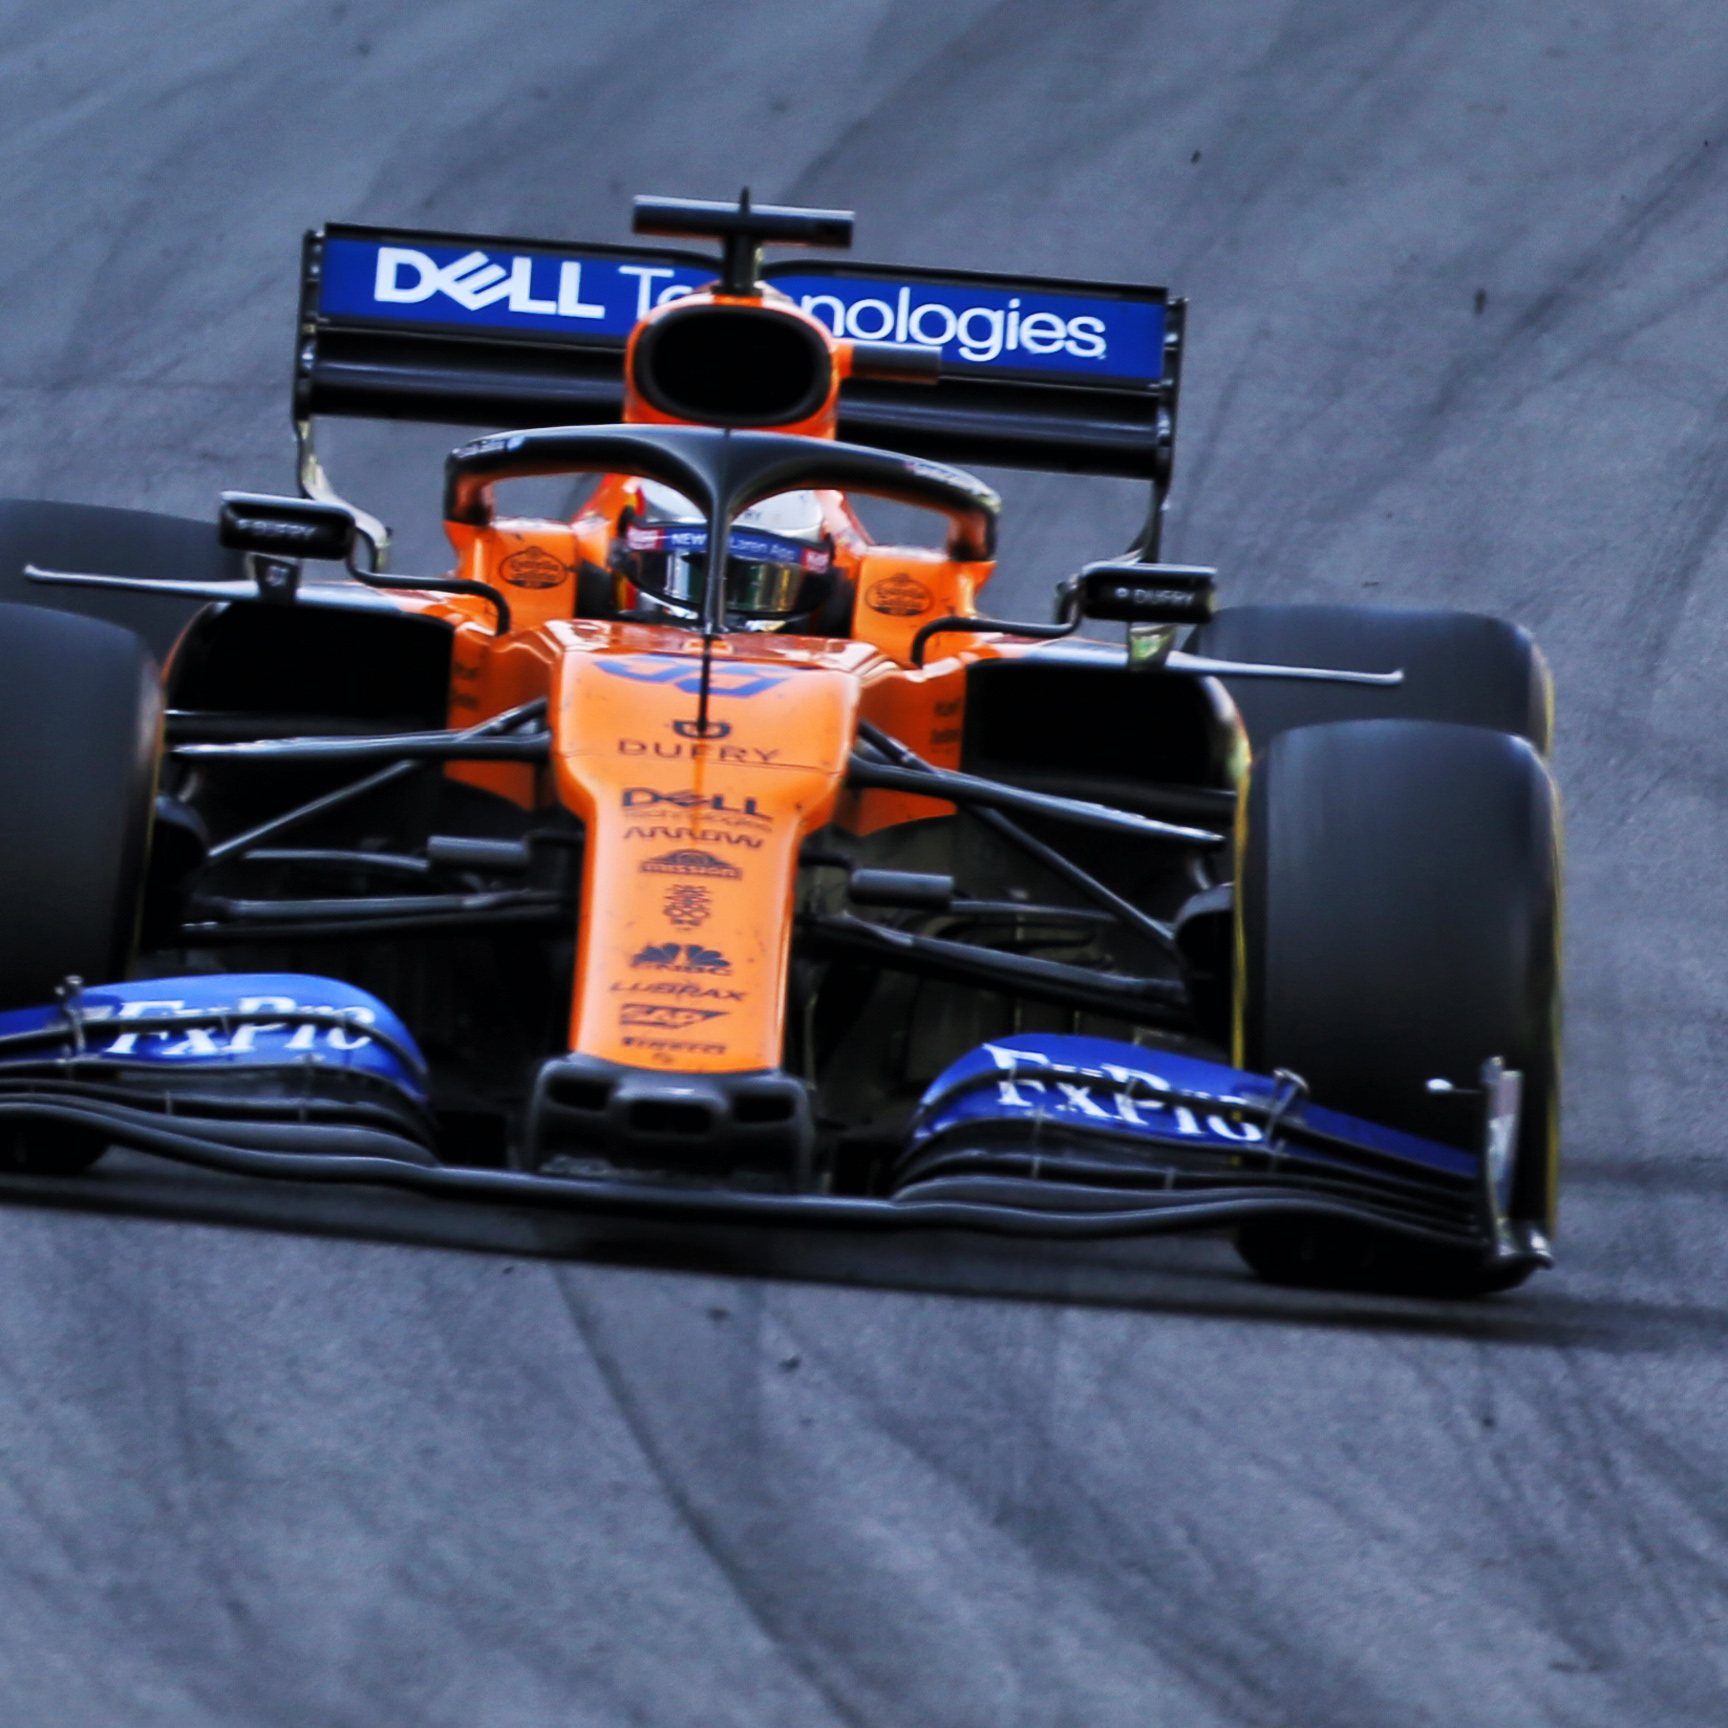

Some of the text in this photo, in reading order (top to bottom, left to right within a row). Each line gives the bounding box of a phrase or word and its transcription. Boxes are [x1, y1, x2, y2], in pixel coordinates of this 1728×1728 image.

[373, 246, 1107, 363] DELL Tnologies
[618, 738, 781, 764] DUFRY
[621, 786, 775, 821] DELL
